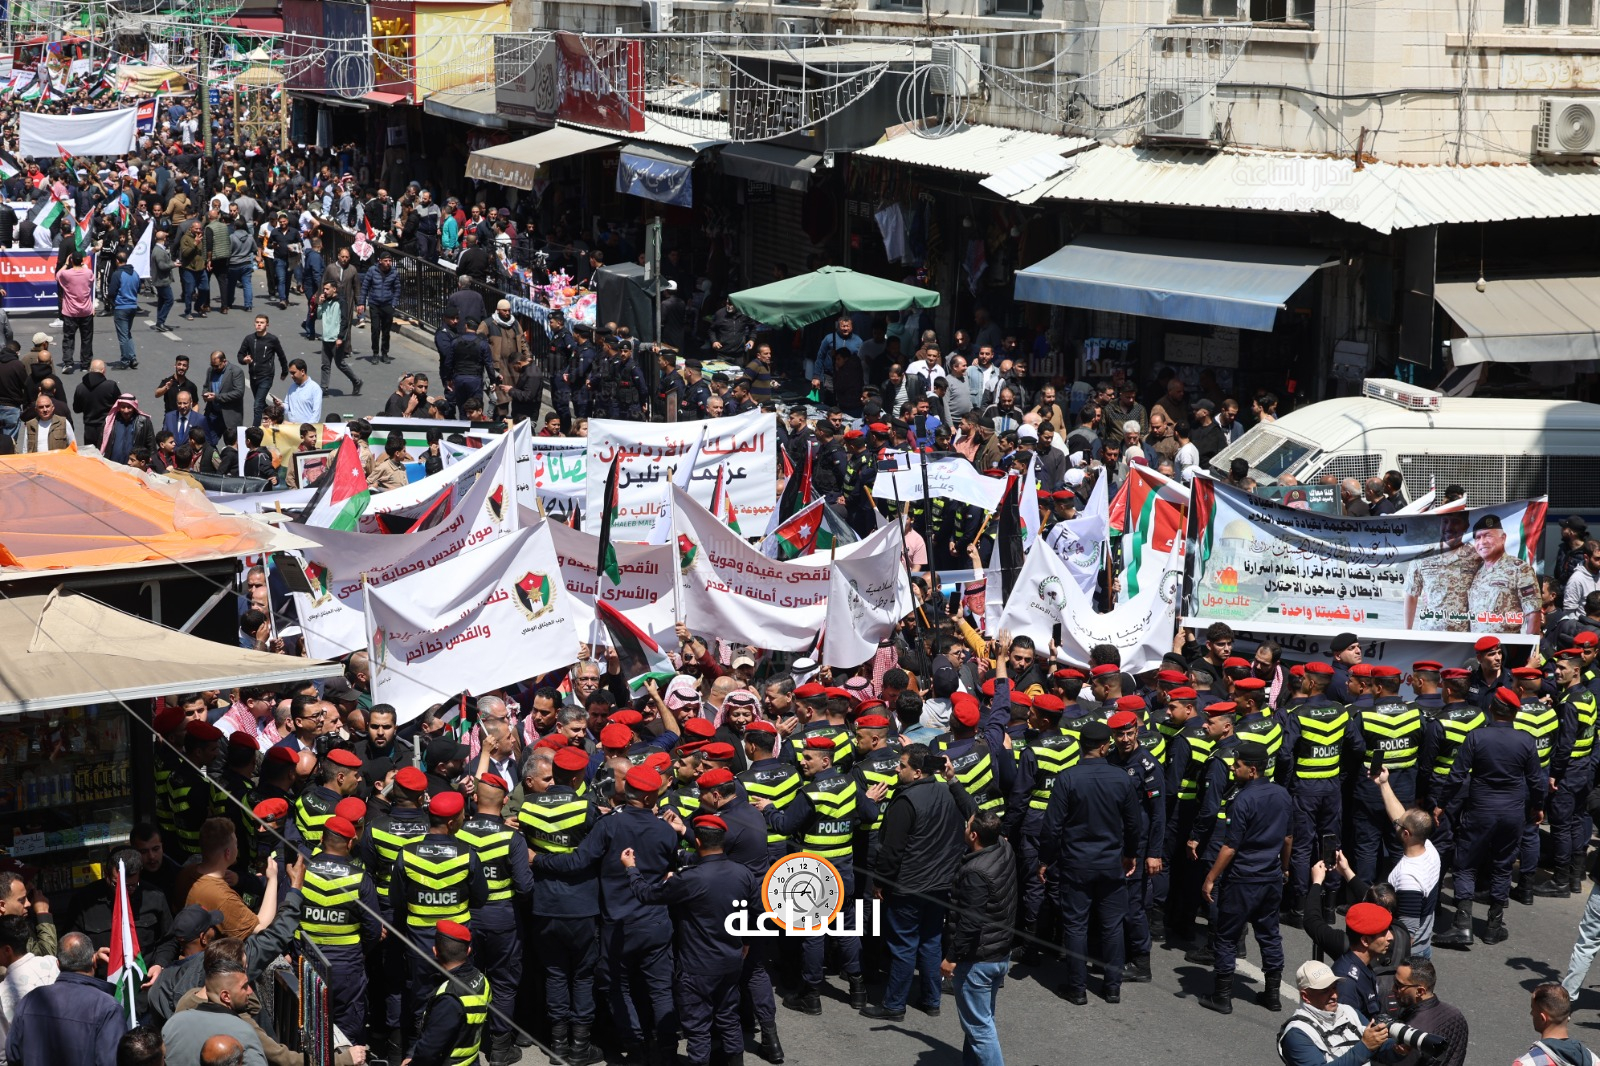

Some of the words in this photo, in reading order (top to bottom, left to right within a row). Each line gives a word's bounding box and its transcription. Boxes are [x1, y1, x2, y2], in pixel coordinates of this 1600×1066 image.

[1, 261, 46, 278] سيدنا
[702, 432, 765, 455] الملك
[1295, 516, 1322, 531] بقيادة
[1323, 519, 1362, 534] الحكيمة
[1364, 519, 1408, 537] الهاشمية
[426, 537, 466, 567] للقدس
[708, 551, 744, 574] وهوية
[745, 560, 783, 580] عقيدة
[381, 559, 426, 583] وحماية
[786, 566, 831, 584] لأقصى
[1302, 564, 1324, 579] لقرار
[1325, 565, 1346, 579] التام
[1349, 566, 1375, 583] رفضنا
[566, 578, 599, 595] أمانة
[602, 585, 658, 604] والأسرى
[1304, 583, 1335, 597] سجون
[1336, 583, 1347, 600] في
[745, 588, 776, 603] أمانة
[1202, 595, 1223, 607] مول
[1225, 593, 1250, 607] غالب
[1281, 602, 1312, 621] واحدة
[1314, 604, 1350, 620] قضيتنا
[1419, 607, 1448, 622] الوطن
[1477, 610, 1504, 624] معاك
[1505, 610, 1524, 624] كلنا
[446, 624, 491, 649] والقدس
[427, 637, 444, 654] خط
[405, 645, 425, 665] أحمر
[1380, 738, 1410, 751] POLICE
[1536, 737, 1549, 749] LICE
[1313, 745, 1339, 758] POLICE
[818, 820, 851, 834] POLICE
[418, 891, 458, 905] POLICE
[305, 907, 346, 923] POLICE
